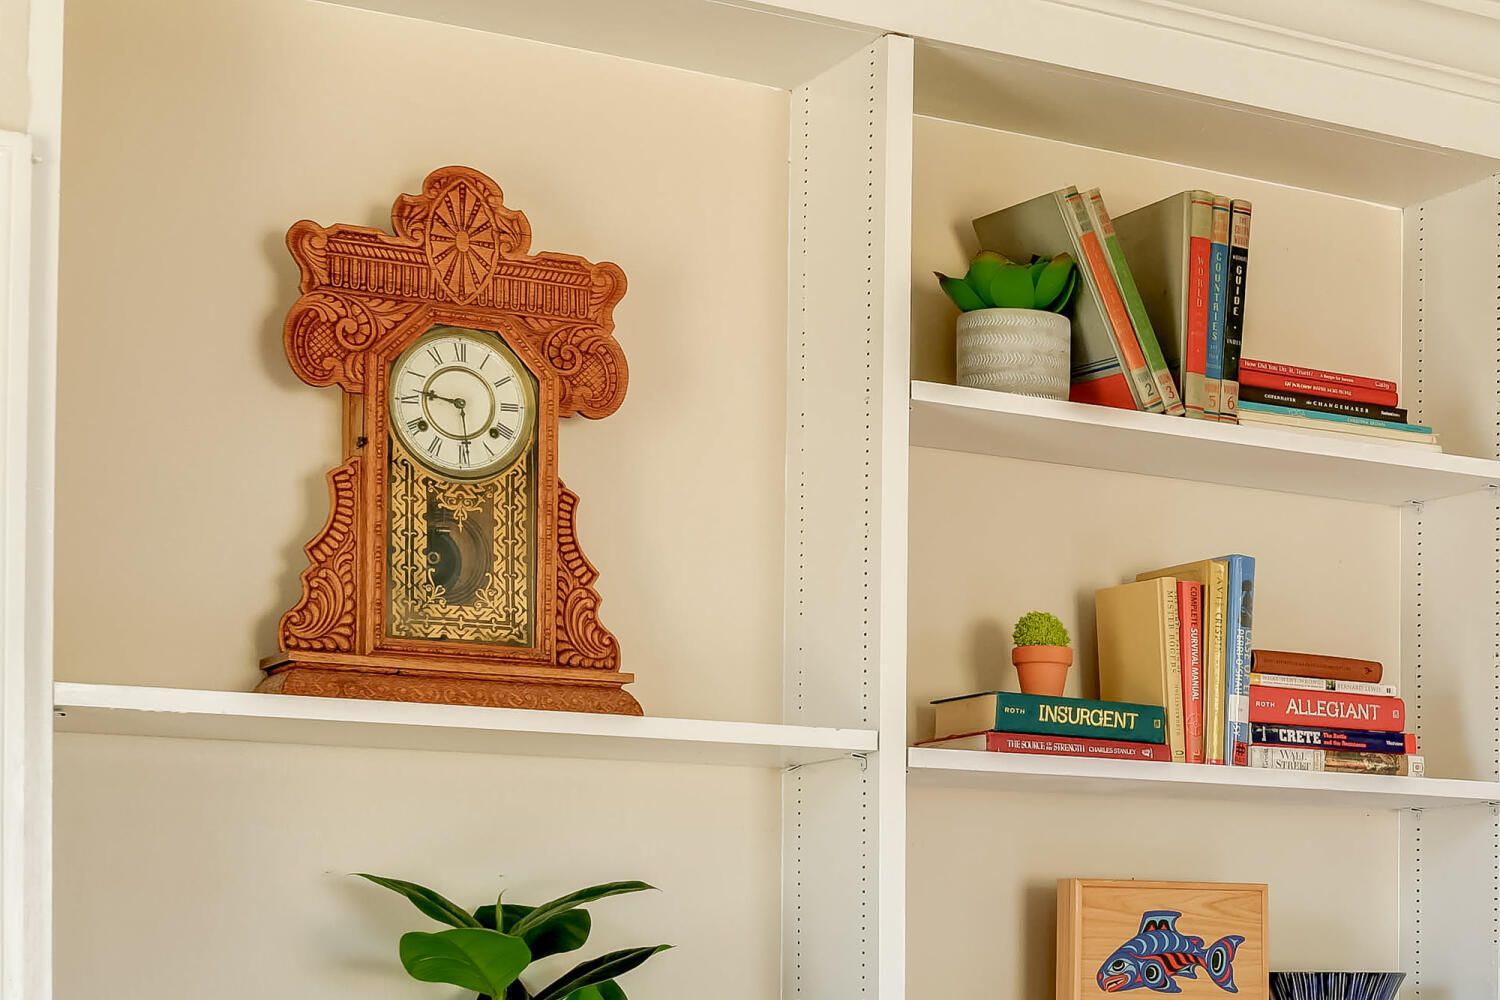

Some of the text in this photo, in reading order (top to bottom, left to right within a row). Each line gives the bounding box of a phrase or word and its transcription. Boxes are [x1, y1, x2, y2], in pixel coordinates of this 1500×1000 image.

[1210, 252, 1222, 340] COUNTRIES
[1233, 265, 1243, 316] GUIDE
[1144, 383, 1154, 397] 2
[1165, 386, 1175, 399] 3
[1208, 396, 1216, 408] 5
[1227, 396, 1235, 410] 6
[1313, 401, 1369, 413] CHANGEMAKER
[1167, 590, 1175, 628] MISTER
[1190, 586, 1200, 702] COMPLETE SURVIVAL MANUAL
[1004, 704, 1139, 730] ROTH INSURGENT
[1286, 699, 1381, 721] ALLEGIANT
[1279, 729, 1321, 745] CRETE
[1007, 739, 1020, 749] THE
[1021, 741, 1045, 750] SOURCE
[1053, 743, 1085, 753] STRENGTH
[1088, 746, 1113, 754] CHARLES
[1280, 749, 1307, 761] WALL
